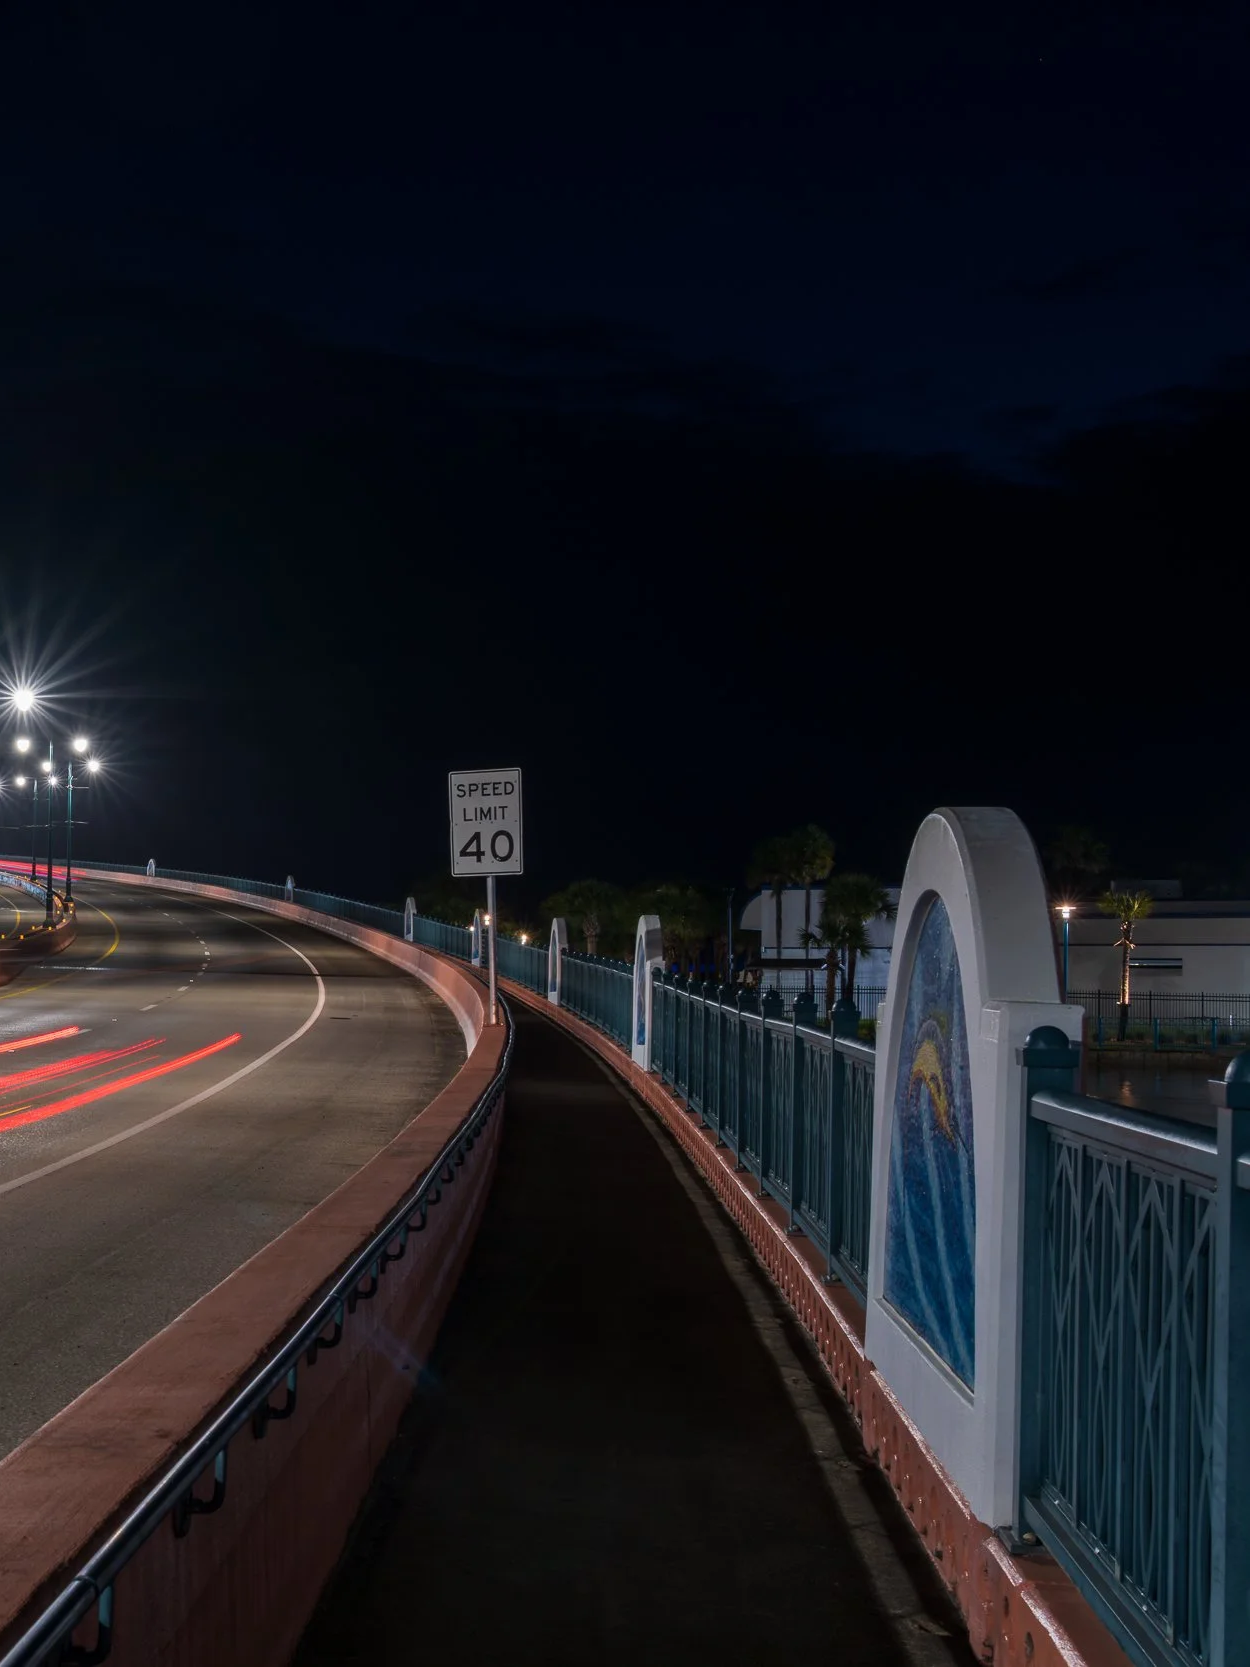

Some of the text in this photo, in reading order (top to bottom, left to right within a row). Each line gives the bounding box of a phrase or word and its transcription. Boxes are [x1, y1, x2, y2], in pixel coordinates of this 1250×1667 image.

[456, 781, 515, 798] SPEED
[463, 805, 508, 822] LIMIT
[459, 829, 515, 863] 40
